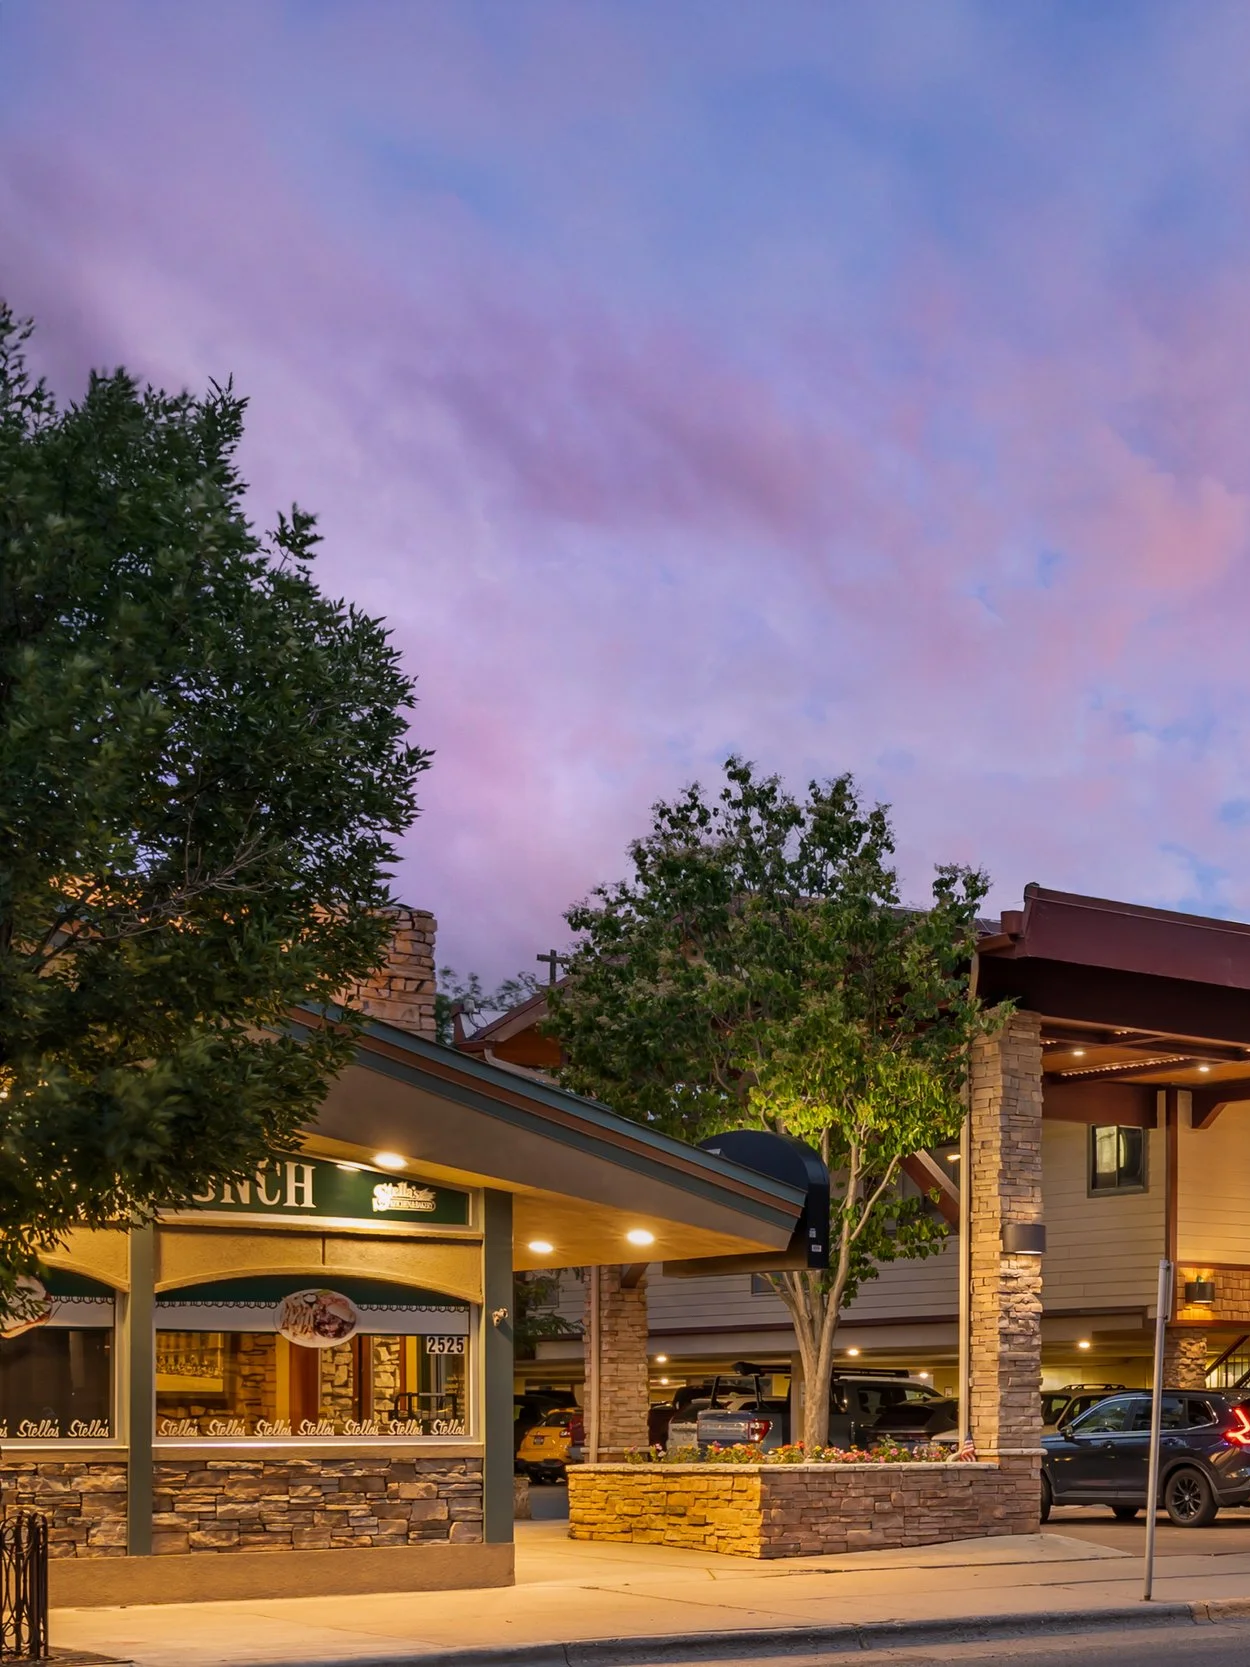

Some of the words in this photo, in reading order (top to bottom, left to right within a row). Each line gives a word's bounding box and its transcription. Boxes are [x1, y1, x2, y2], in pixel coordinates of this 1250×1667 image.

[428, 1336, 464, 1353] 2525
[16, 1419, 60, 1438] Stella's
[67, 1419, 109, 1438] Stella's
[158, 1418, 198, 1436] Stella's
[206, 1418, 246, 1436] Stella's
[254, 1418, 292, 1437] Stella's
[297, 1418, 335, 1436] Stella's
[342, 1418, 379, 1436] Stella's
[387, 1418, 423, 1436] Stella's
[430, 1418, 465, 1436] Stella's
